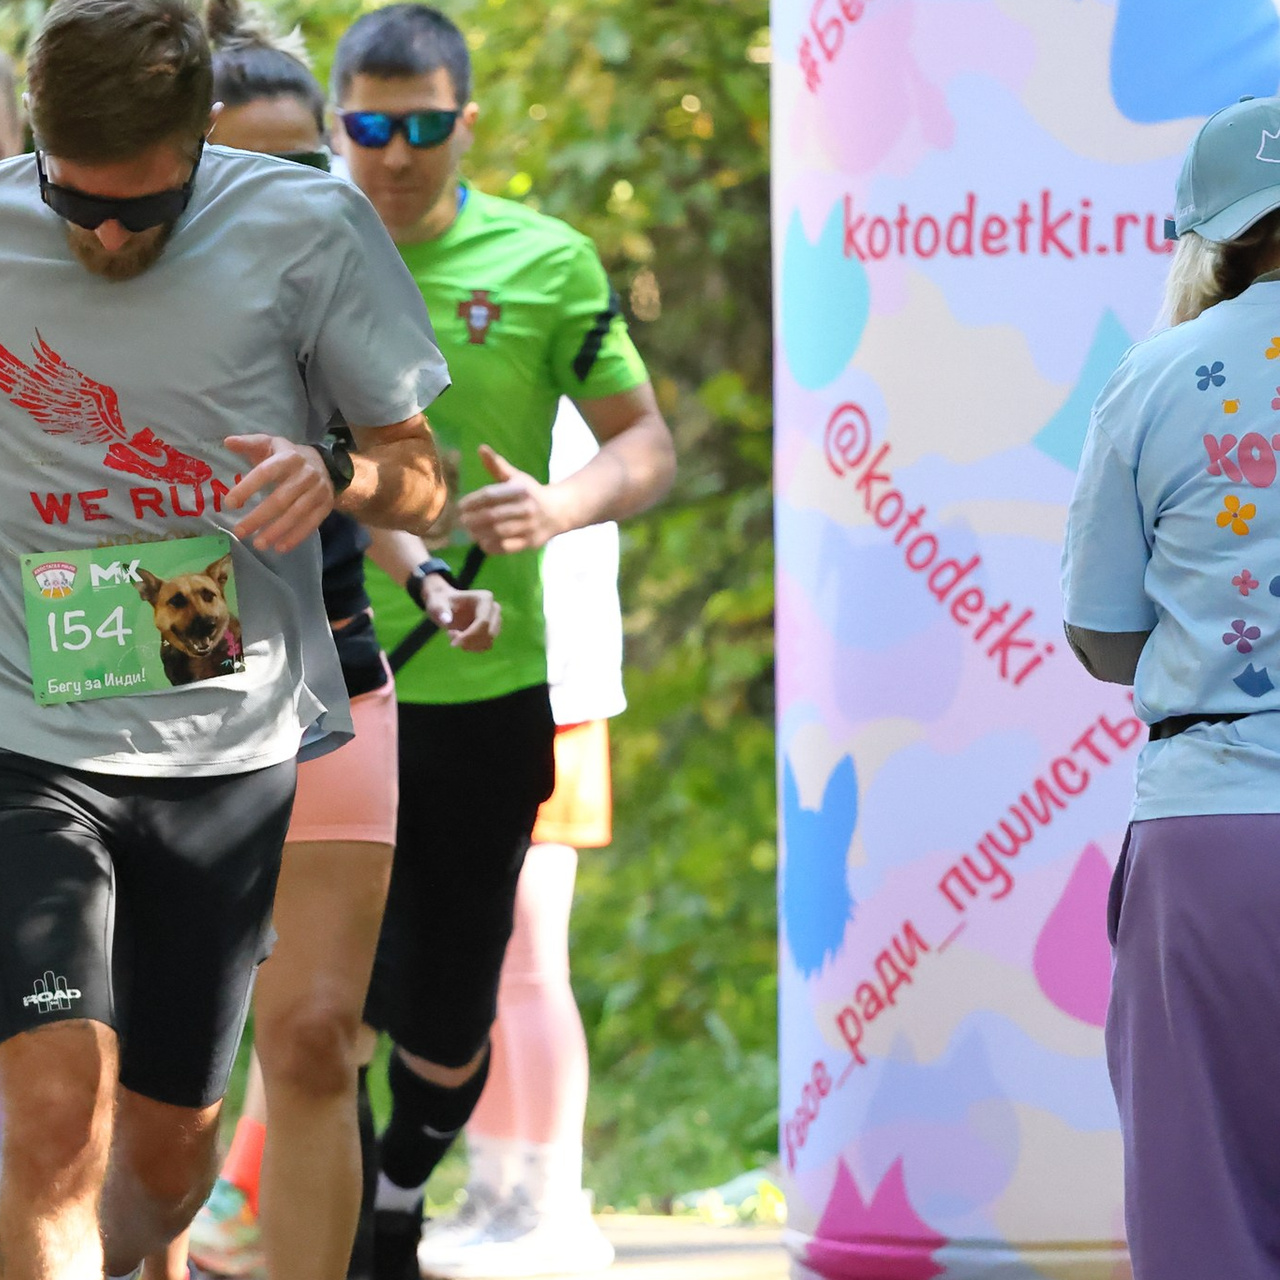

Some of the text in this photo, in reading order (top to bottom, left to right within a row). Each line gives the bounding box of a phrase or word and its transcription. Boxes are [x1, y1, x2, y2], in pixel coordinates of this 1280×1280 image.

[841, 188, 1175, 261] kotodetki.ru
[30, 472, 246, 526] WE RUN
[823, 401, 1056, 687] @kotodetki
[48, 605, 133, 652] 154
[47, 667, 146, 696] Бегу за Инди!
